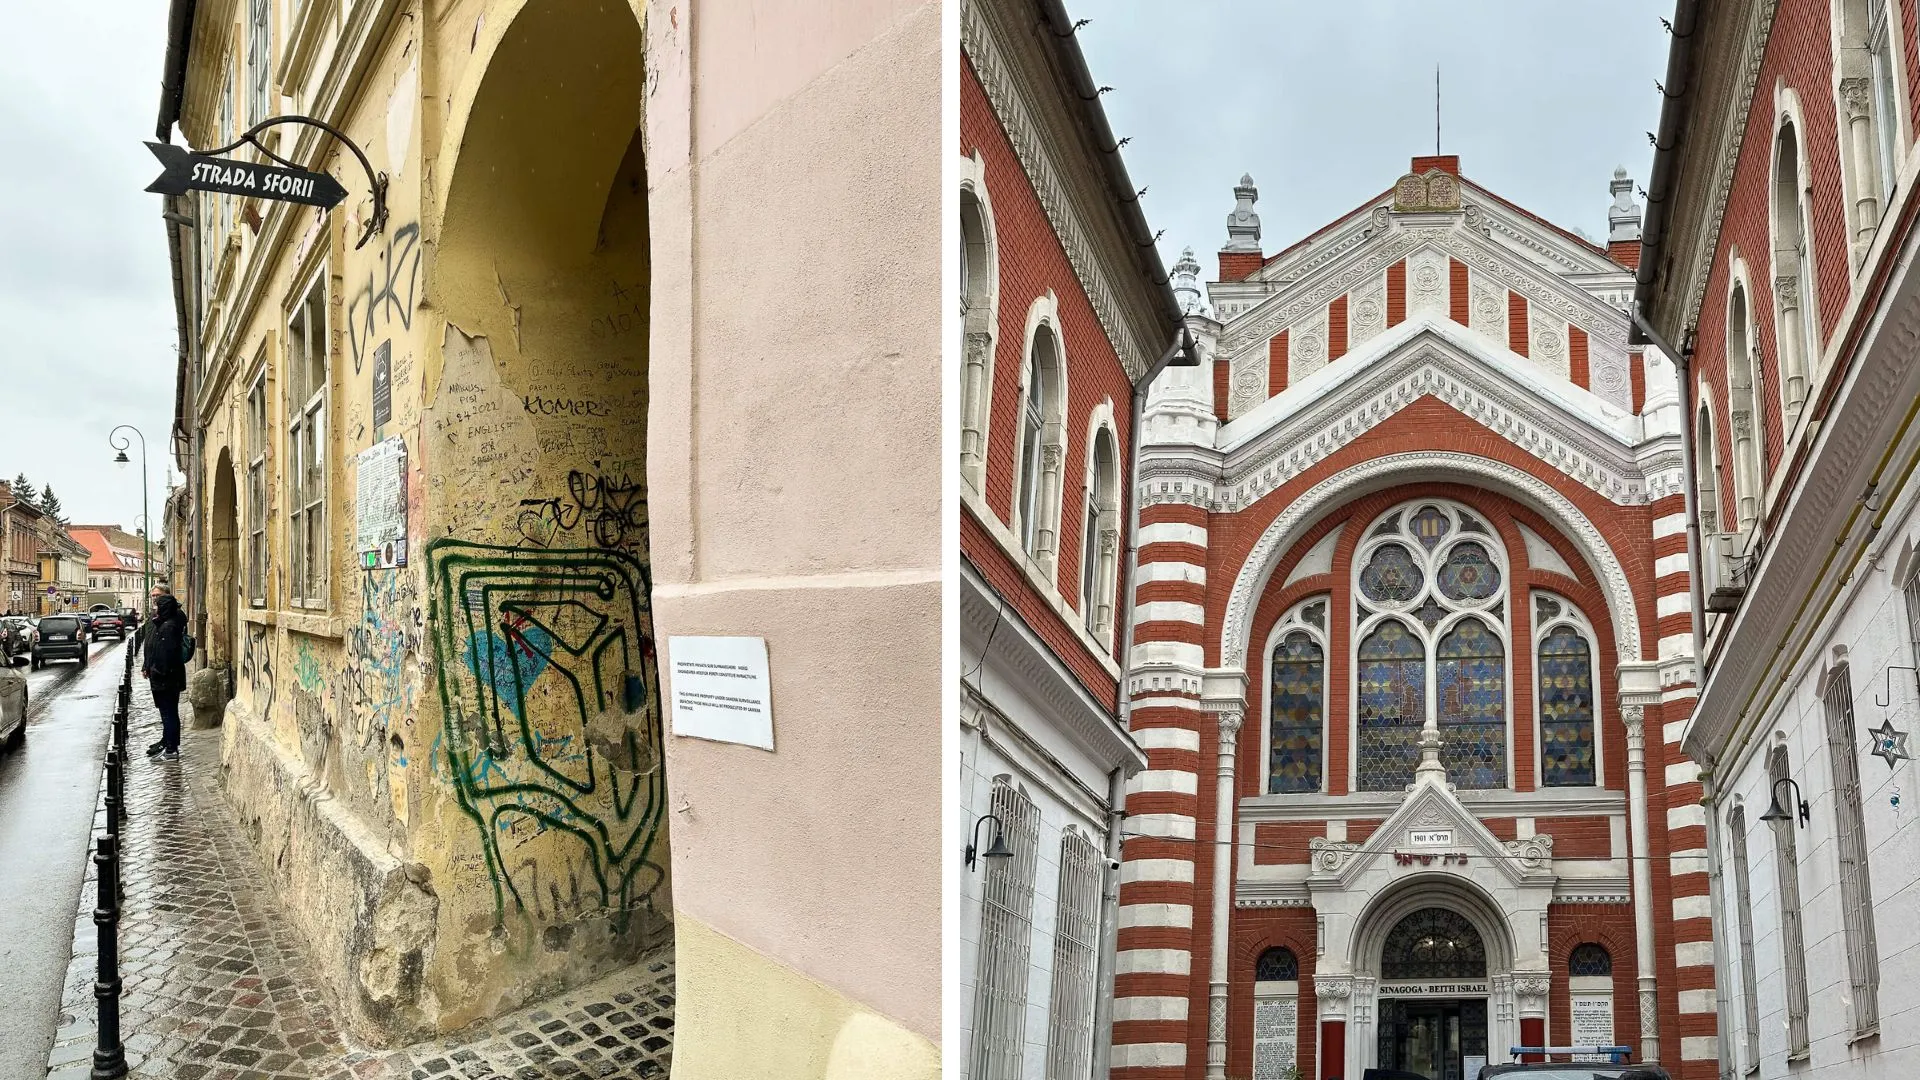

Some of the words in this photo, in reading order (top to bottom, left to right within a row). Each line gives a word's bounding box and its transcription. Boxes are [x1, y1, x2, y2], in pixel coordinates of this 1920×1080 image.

[191, 162, 256, 189] STRADA
[262, 172, 315, 198] SFORII
[1414, 834, 1426, 842] 1901
[1380, 986, 1423, 994] SINAGOGA
[1429, 985, 1455, 993] BEITH
